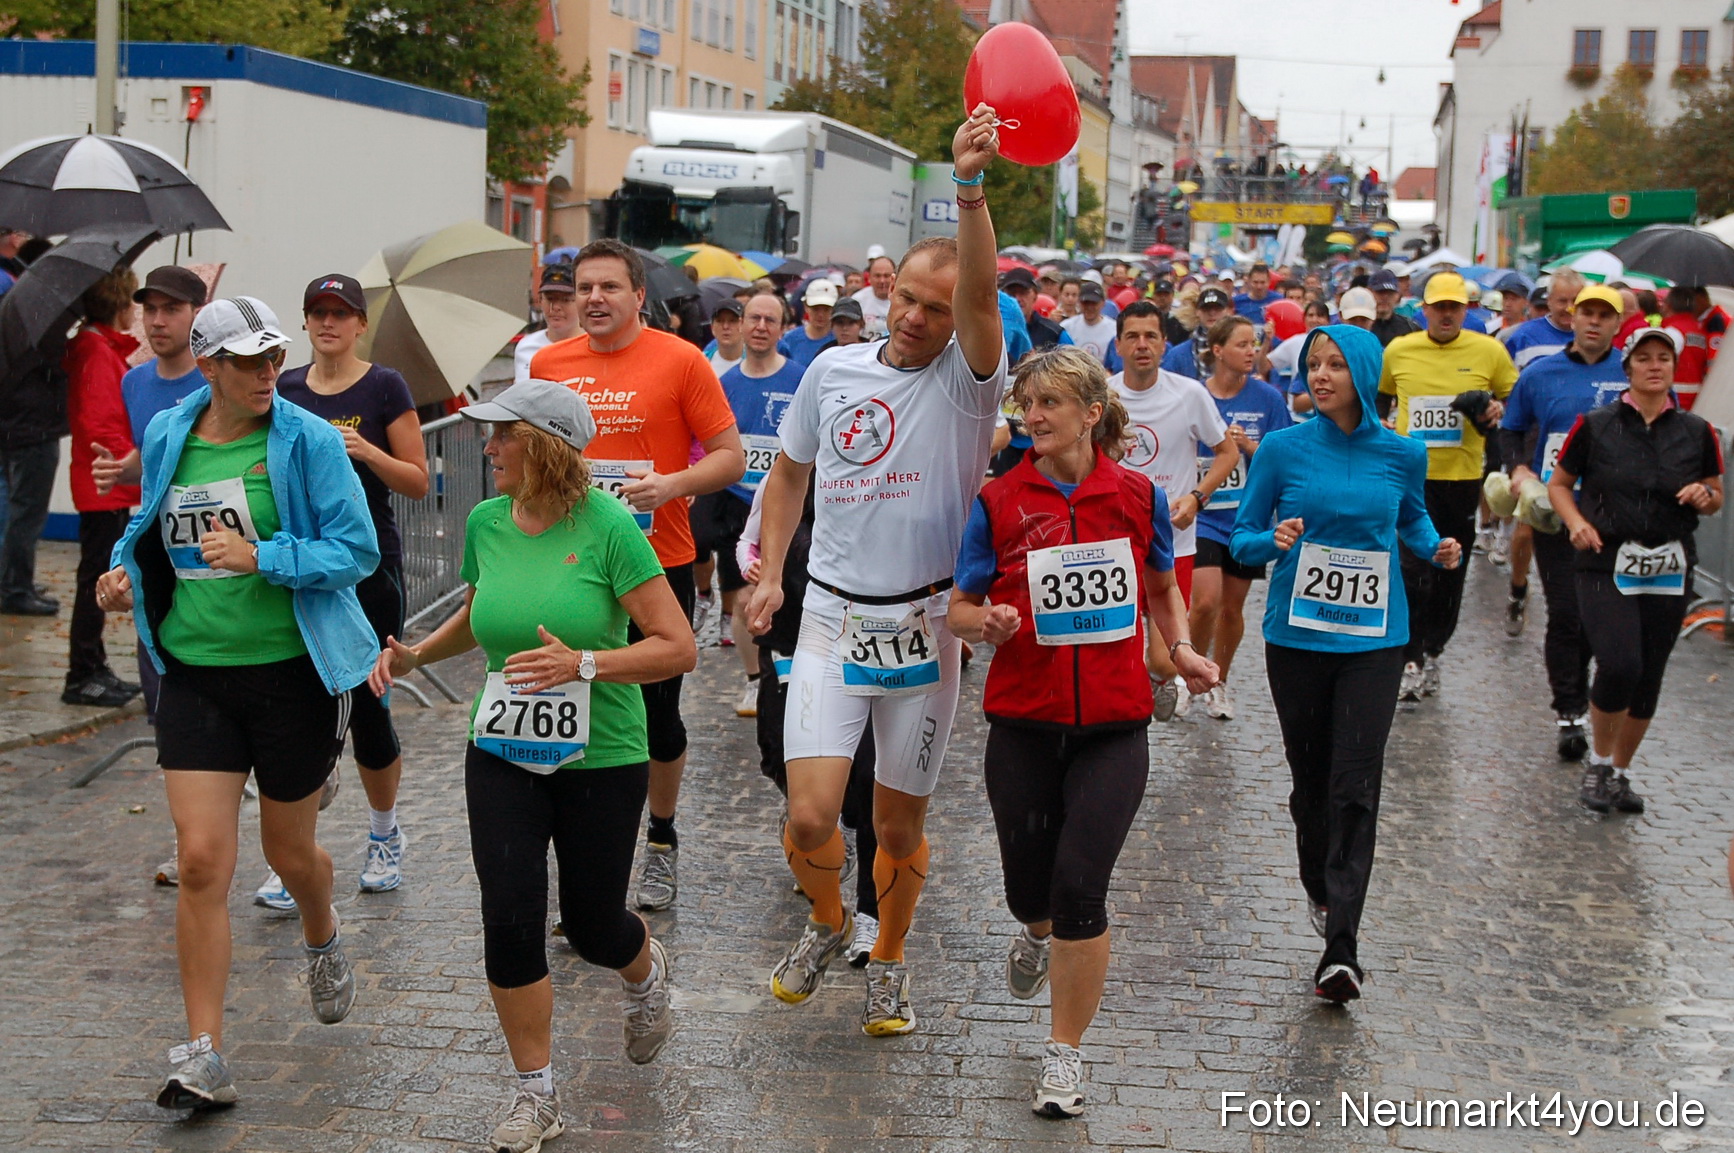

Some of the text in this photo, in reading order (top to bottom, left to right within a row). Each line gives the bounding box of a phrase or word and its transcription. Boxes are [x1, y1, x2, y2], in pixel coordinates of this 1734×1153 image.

[663, 162, 738, 179] BOCK
[1235, 208, 1284, 217] START
[1413, 410, 1458, 428] 3035
[820, 471, 920, 489] LAUFEN MIT HERZ
[824, 496, 834, 504] Dr.
[836, 495, 856, 504] Heck
[863, 494, 877, 502] Dr.
[879, 489, 909, 500] Röschl
[1062, 549, 1105, 562] BOCK
[1329, 553, 1366, 565] BOCK
[1624, 552, 1679, 576] 2674
[1041, 567, 1128, 610] 3333
[1303, 567, 1380, 605] 2913
[1073, 613, 1105, 630] Gabi
[1316, 607, 1360, 622] Andrea
[861, 620, 899, 630] BOCK
[876, 673, 906, 686] Knut
[486, 699, 578, 738] 2768
[917, 716, 937, 772] 2XU
[500, 743, 561, 764] Theresia
